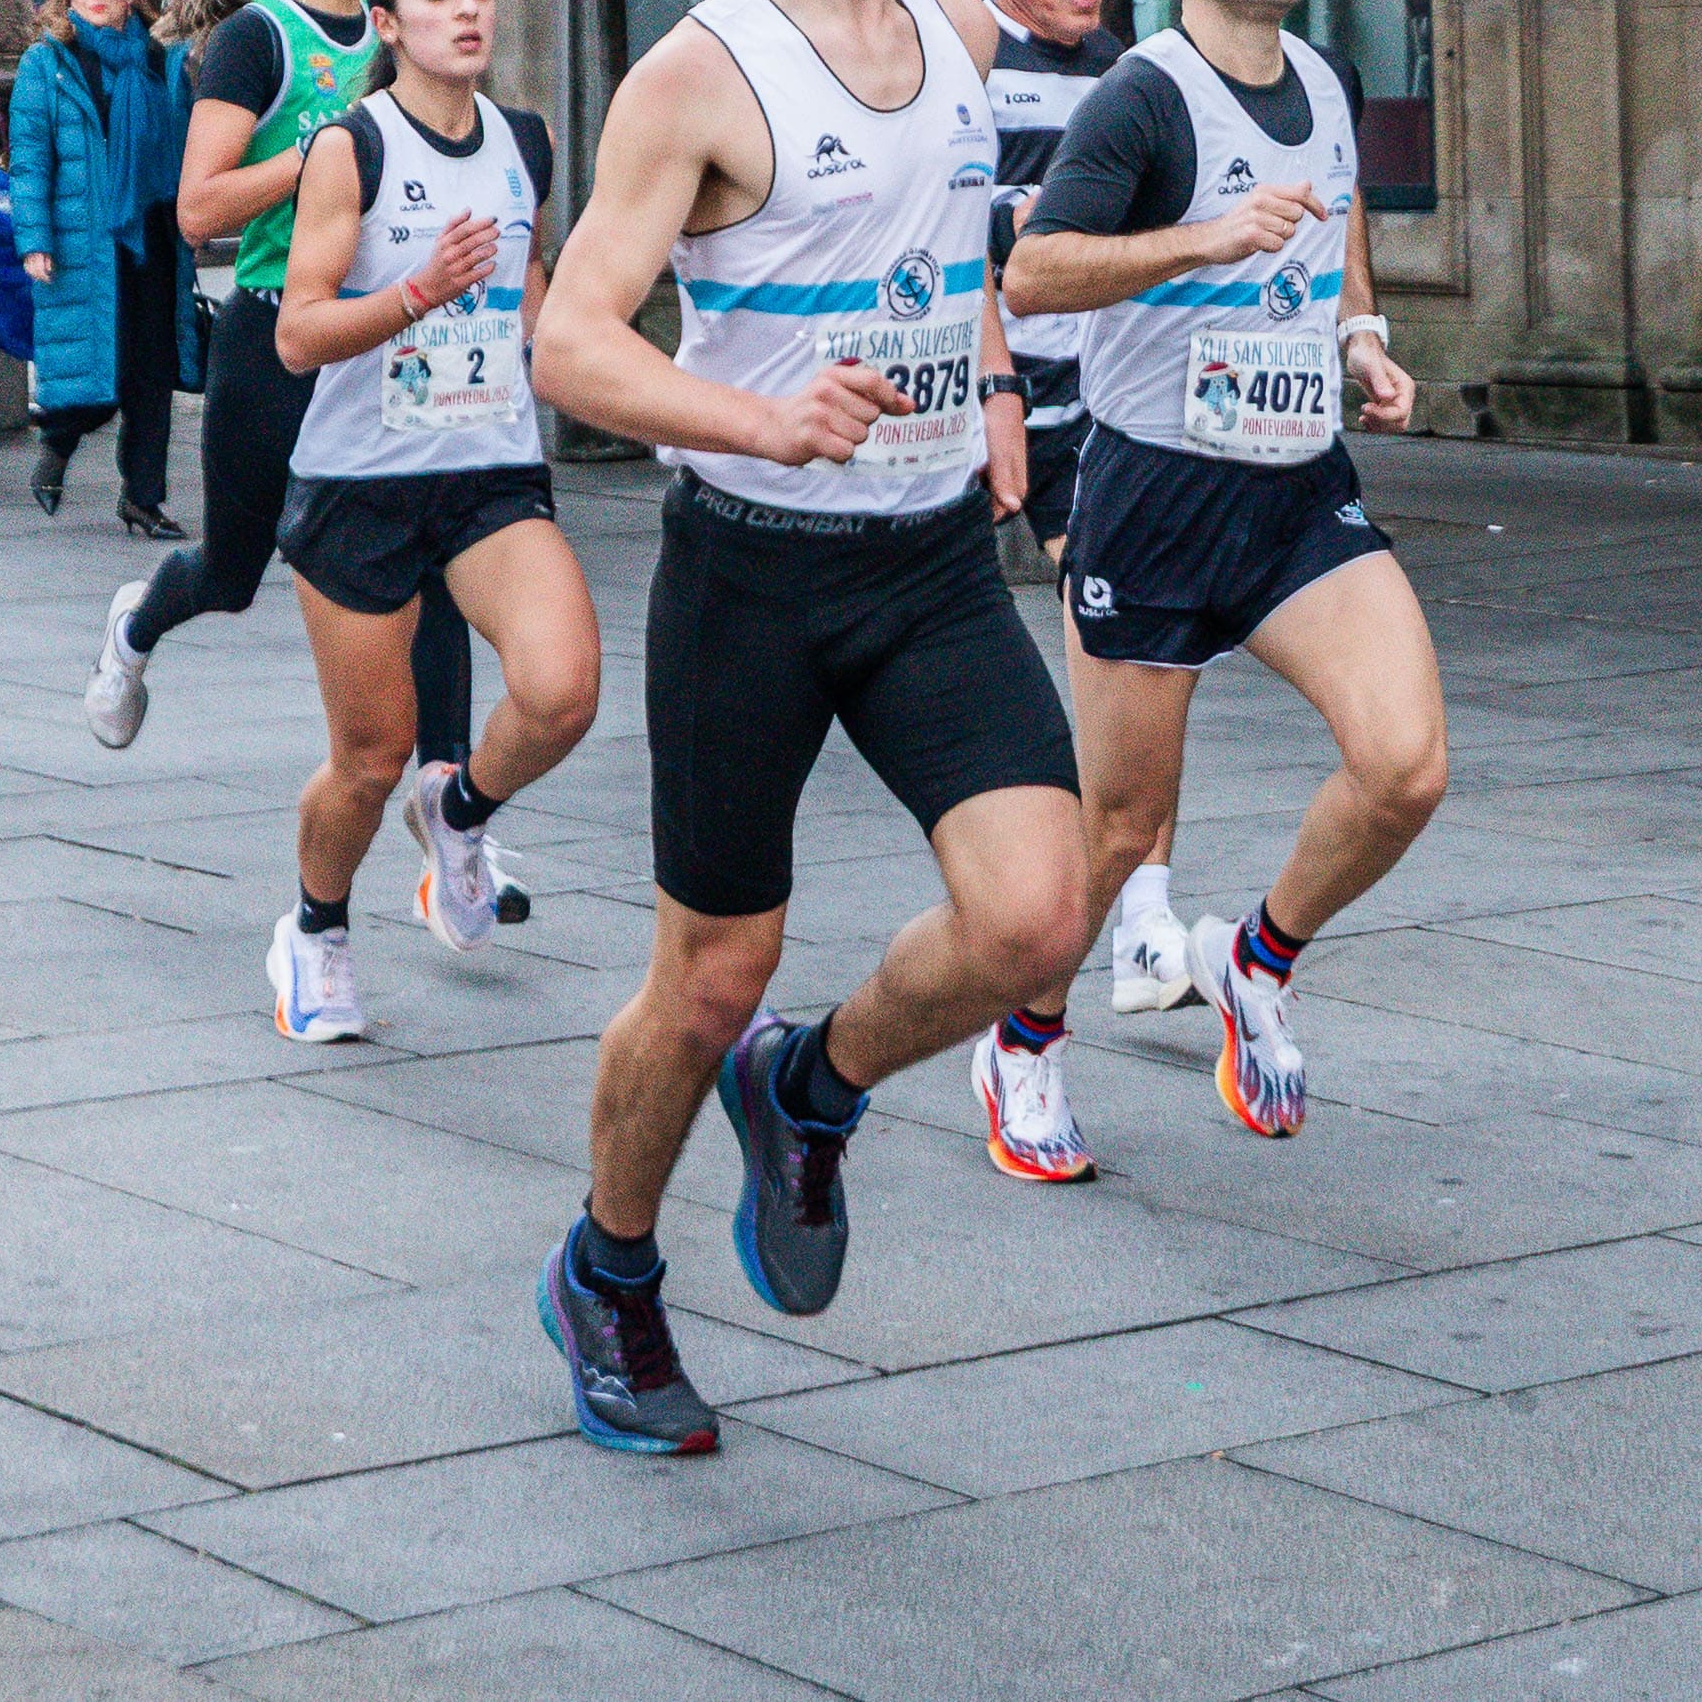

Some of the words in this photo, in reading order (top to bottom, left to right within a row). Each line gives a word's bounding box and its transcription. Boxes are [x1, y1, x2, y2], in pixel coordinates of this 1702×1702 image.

[421, 325, 448, 347] SAN
[453, 318, 510, 345] SILVESTRE
[867, 330, 903, 359] SAN
[910, 319, 975, 358] SILVESTRE
[467, 347, 485, 384] 2
[1198, 338, 1227, 362] XLII
[1232, 340, 1262, 365] SAN
[1267, 342, 1324, 368] SILVESTRE
[433, 387, 491, 407] PONTEVEDRA
[1246, 370, 1325, 414] 4072
[875, 418, 945, 445] PONTEVEDRA
[948, 412, 967, 436] 2025
[1242, 417, 1304, 438] PONTEVEDRA
[1306, 420, 1327, 439] 2025
[694, 484, 745, 522] PRO
[745, 505, 869, 534] COMBAT
